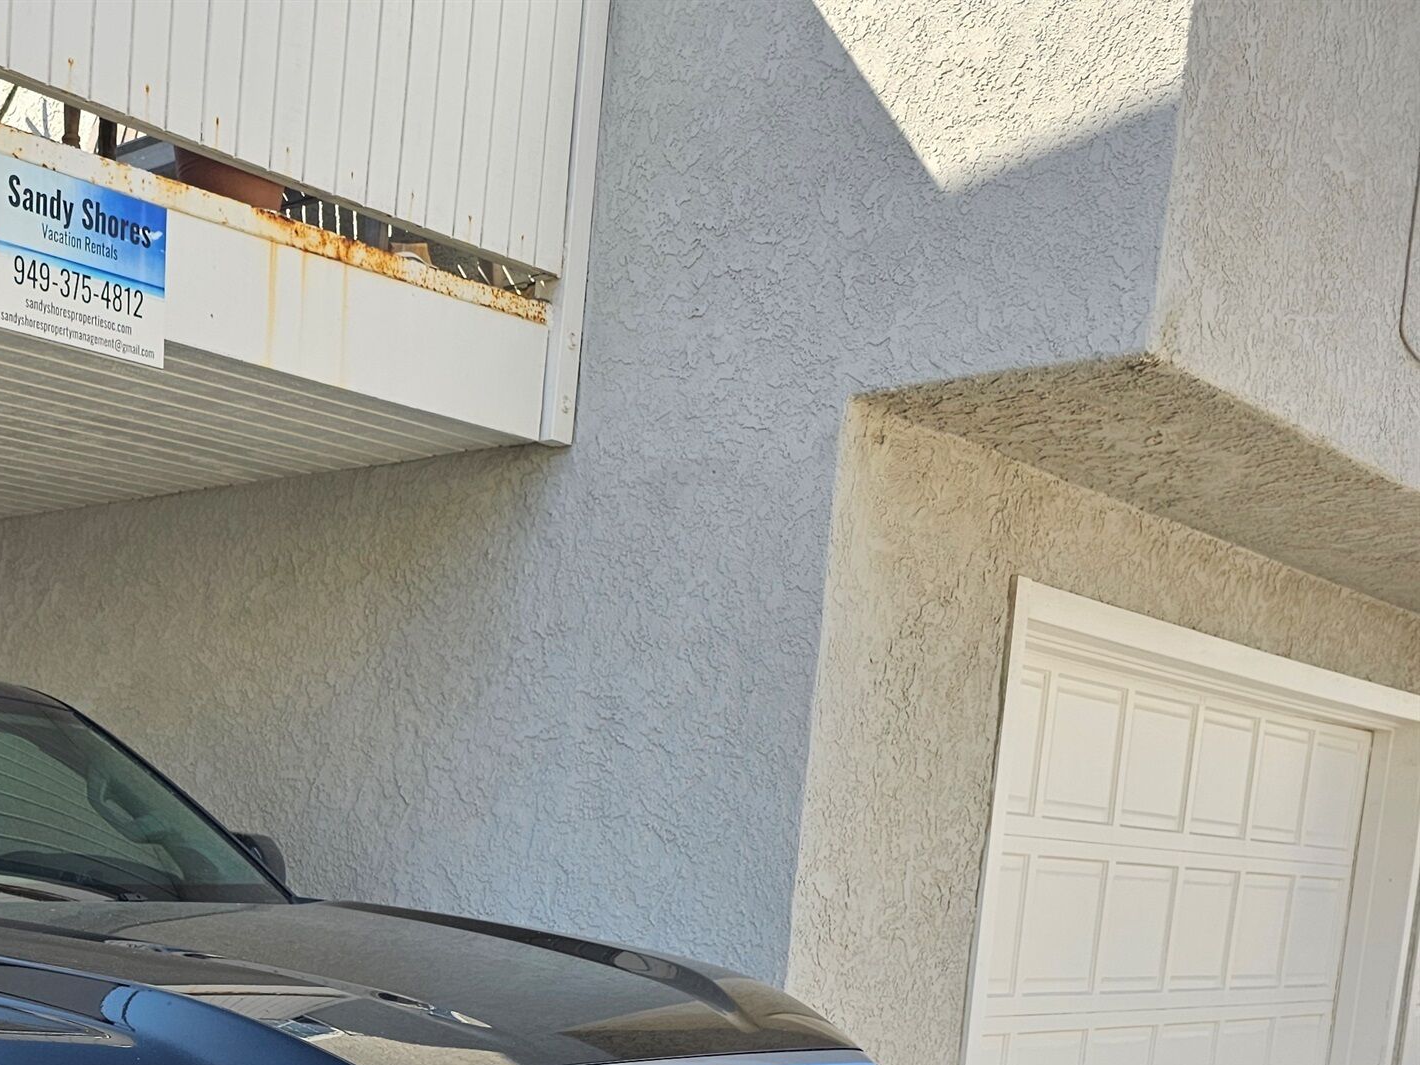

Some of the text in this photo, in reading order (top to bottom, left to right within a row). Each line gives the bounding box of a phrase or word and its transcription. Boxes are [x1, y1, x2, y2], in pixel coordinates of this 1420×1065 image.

[8, 174, 152, 249] Sandy Shores
[41, 222, 118, 261] Vacation Rentals
[13, 255, 144, 319] 949-375-4812
[0, 311, 155, 359] sandyshorespropertymanagement@gmail.com
[25, 298, 132, 335] sandyshorespropertiesoc.com
